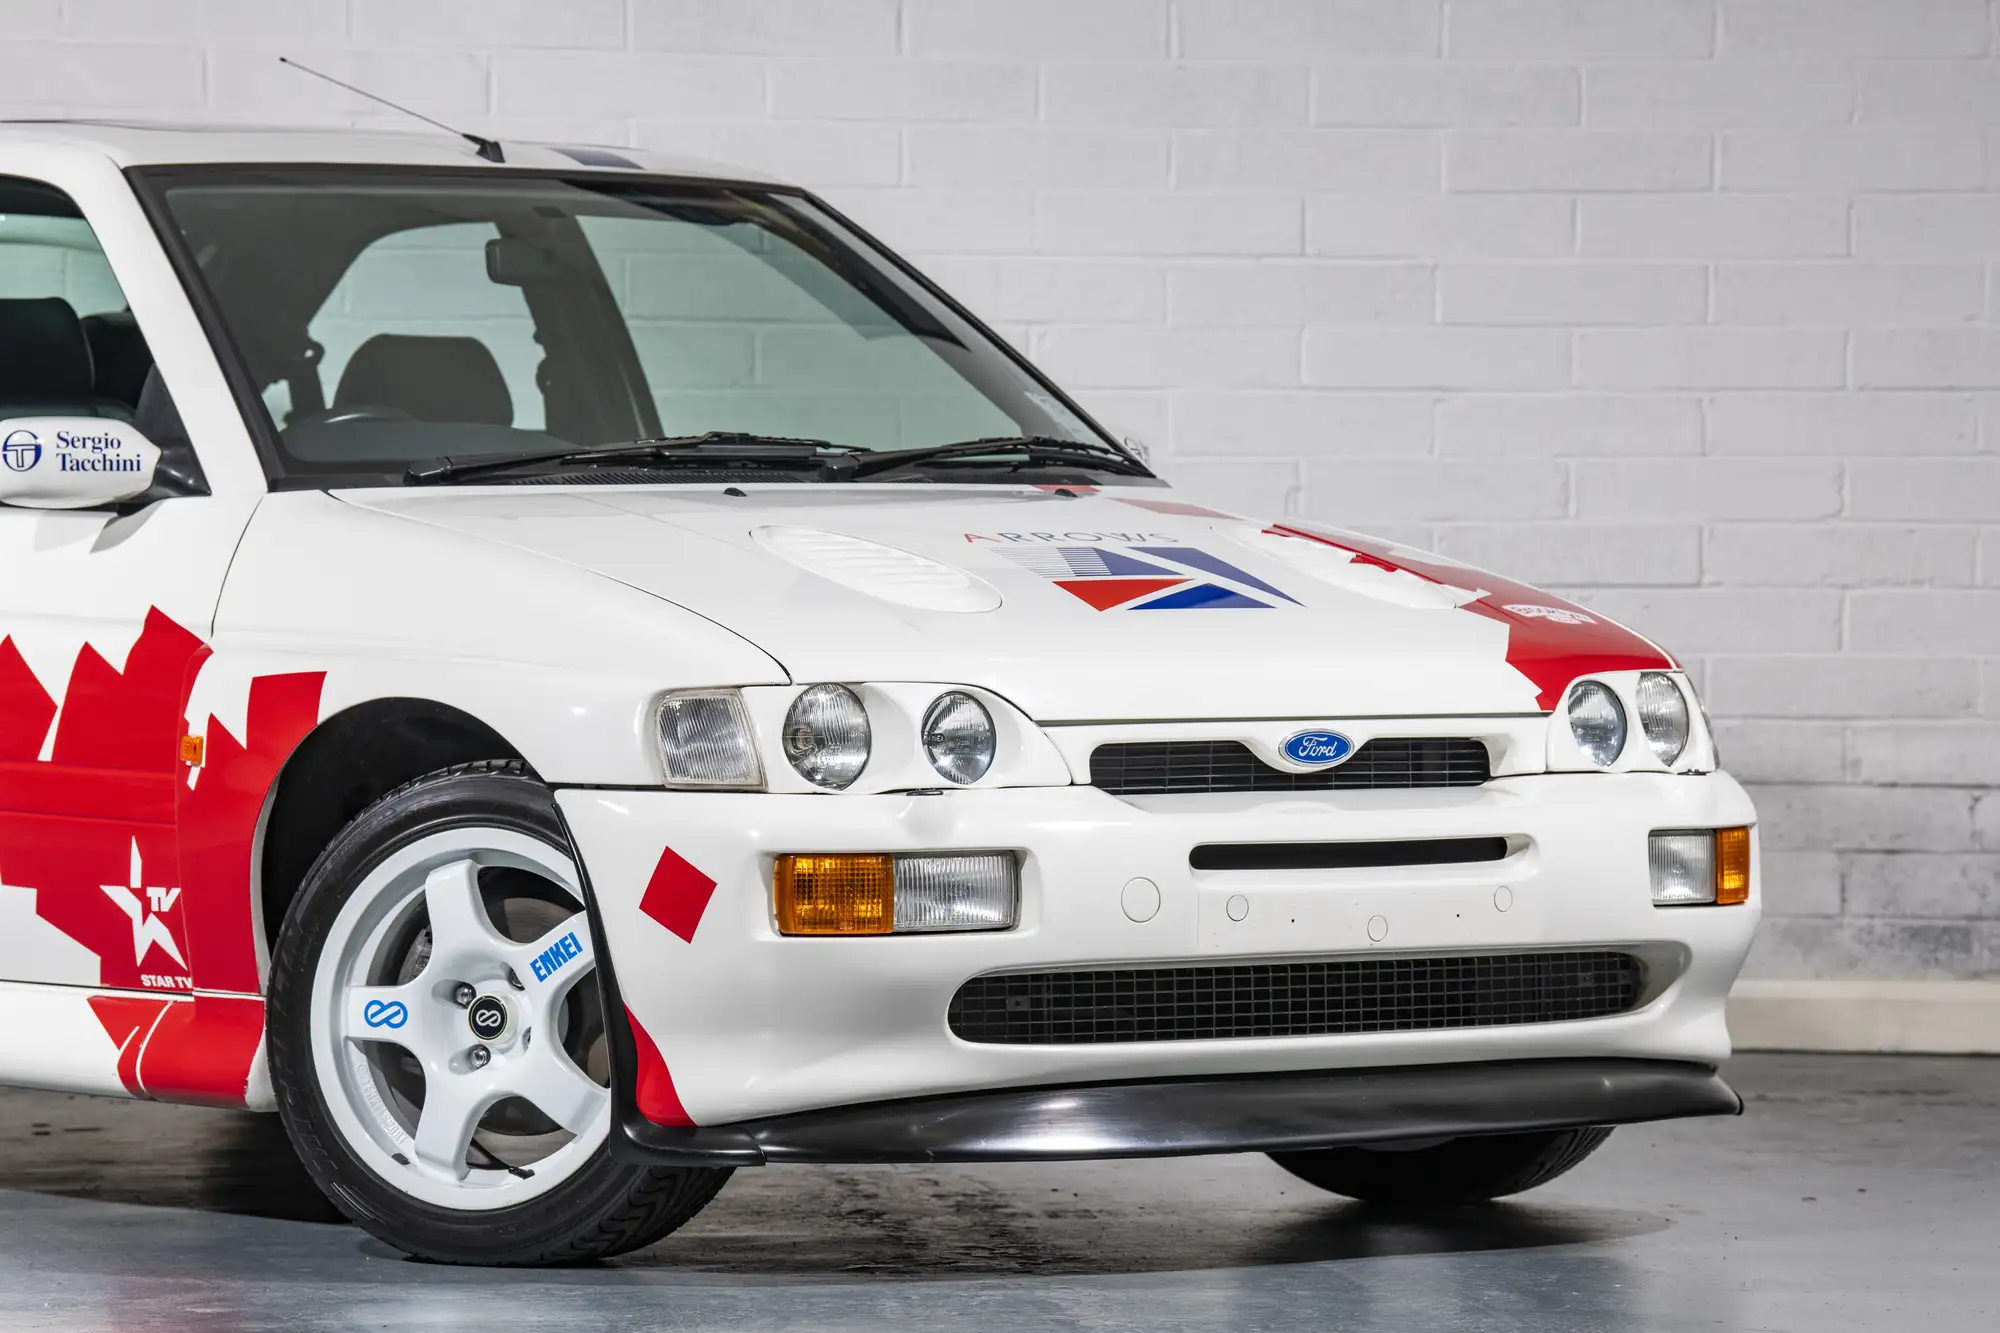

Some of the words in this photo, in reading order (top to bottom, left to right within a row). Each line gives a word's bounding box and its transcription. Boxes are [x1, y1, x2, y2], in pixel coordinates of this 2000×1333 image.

[56, 431, 121, 453] Sergio
[56, 453, 141, 472] Tacchini
[963, 531, 1179, 543] ARROWS
[1298, 736, 1338, 757] Ford
[146, 887, 181, 912] TV
[529, 931, 583, 983] ENKEI
[140, 974, 176, 988] STAR
[174, 976, 192, 989] TV
